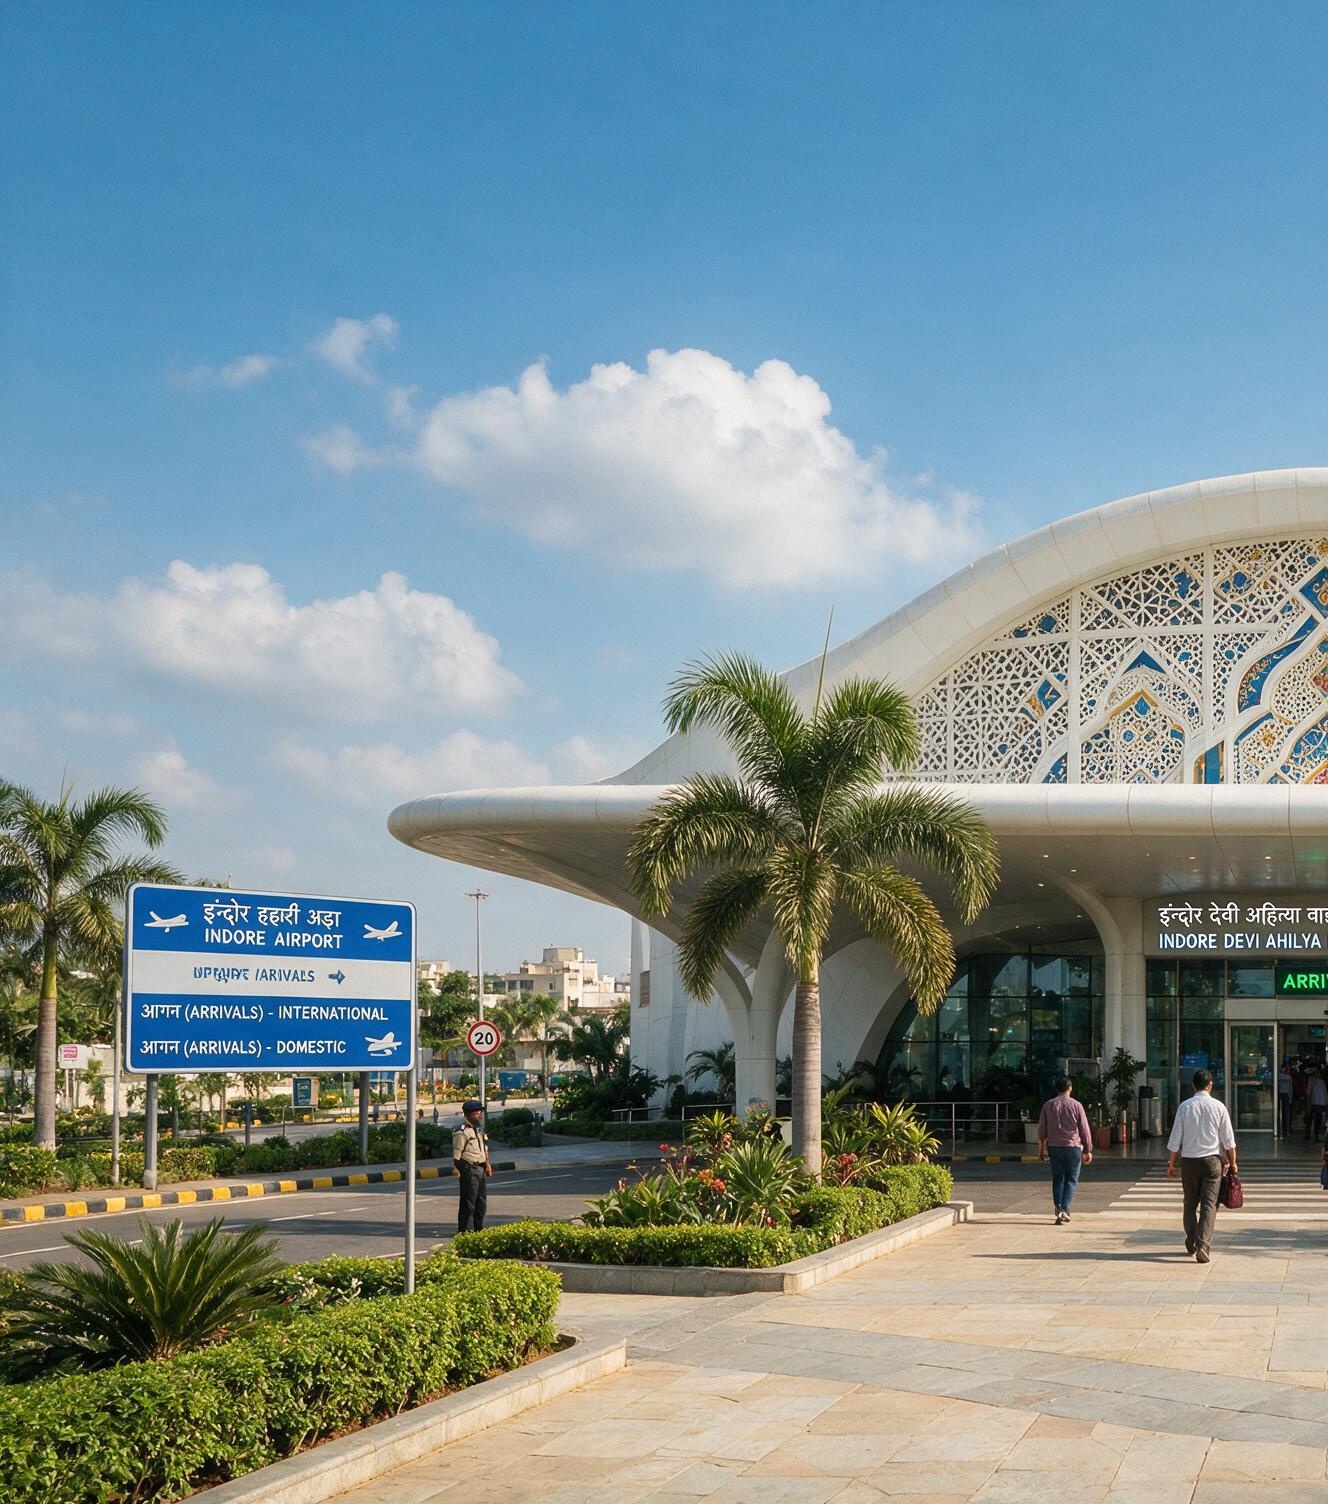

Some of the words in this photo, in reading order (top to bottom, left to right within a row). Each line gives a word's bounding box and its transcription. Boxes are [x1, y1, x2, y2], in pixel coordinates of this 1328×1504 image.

[1208, 902, 1240, 925] देवी
[206, 929, 265, 945] INDORE
[275, 933, 342, 948] AIRPORT
[1160, 934, 1217, 948] INDORE
[1225, 934, 1259, 948] DEVI
[1266, 933, 1321, 948] AHILYA
[185, 1005, 263, 1022] (ARRIVALS)
[279, 1006, 388, 1020] INTERNATIONAL
[475, 1032, 493, 1045] 20
[184, 1040, 261, 1057] (ARRIVALS)
[277, 1041, 345, 1053] DOMESTIC
